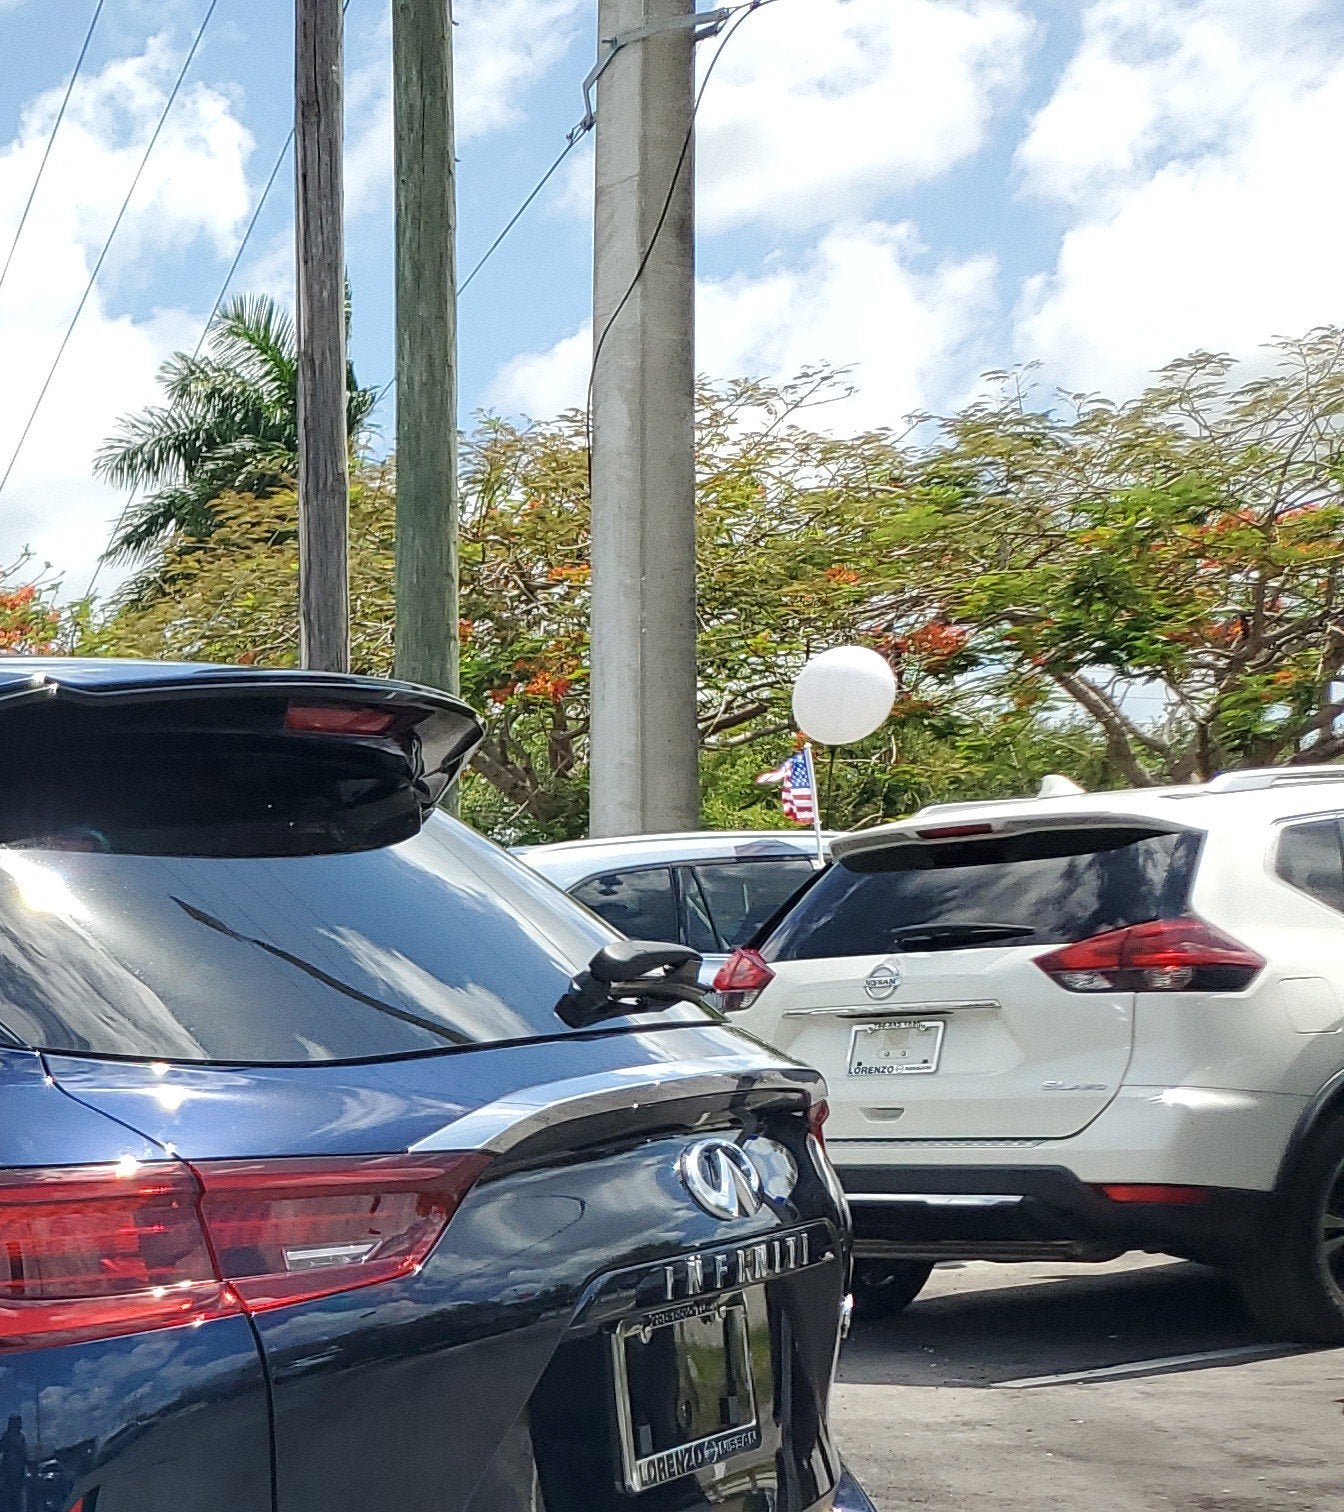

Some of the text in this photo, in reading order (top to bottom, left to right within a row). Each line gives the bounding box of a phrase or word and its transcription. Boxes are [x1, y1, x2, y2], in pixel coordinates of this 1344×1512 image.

[848, 1065, 894, 1075] LORENZO
[664, 1232, 809, 1300] INFINITI
[638, 1444, 703, 1485] LORENZO
